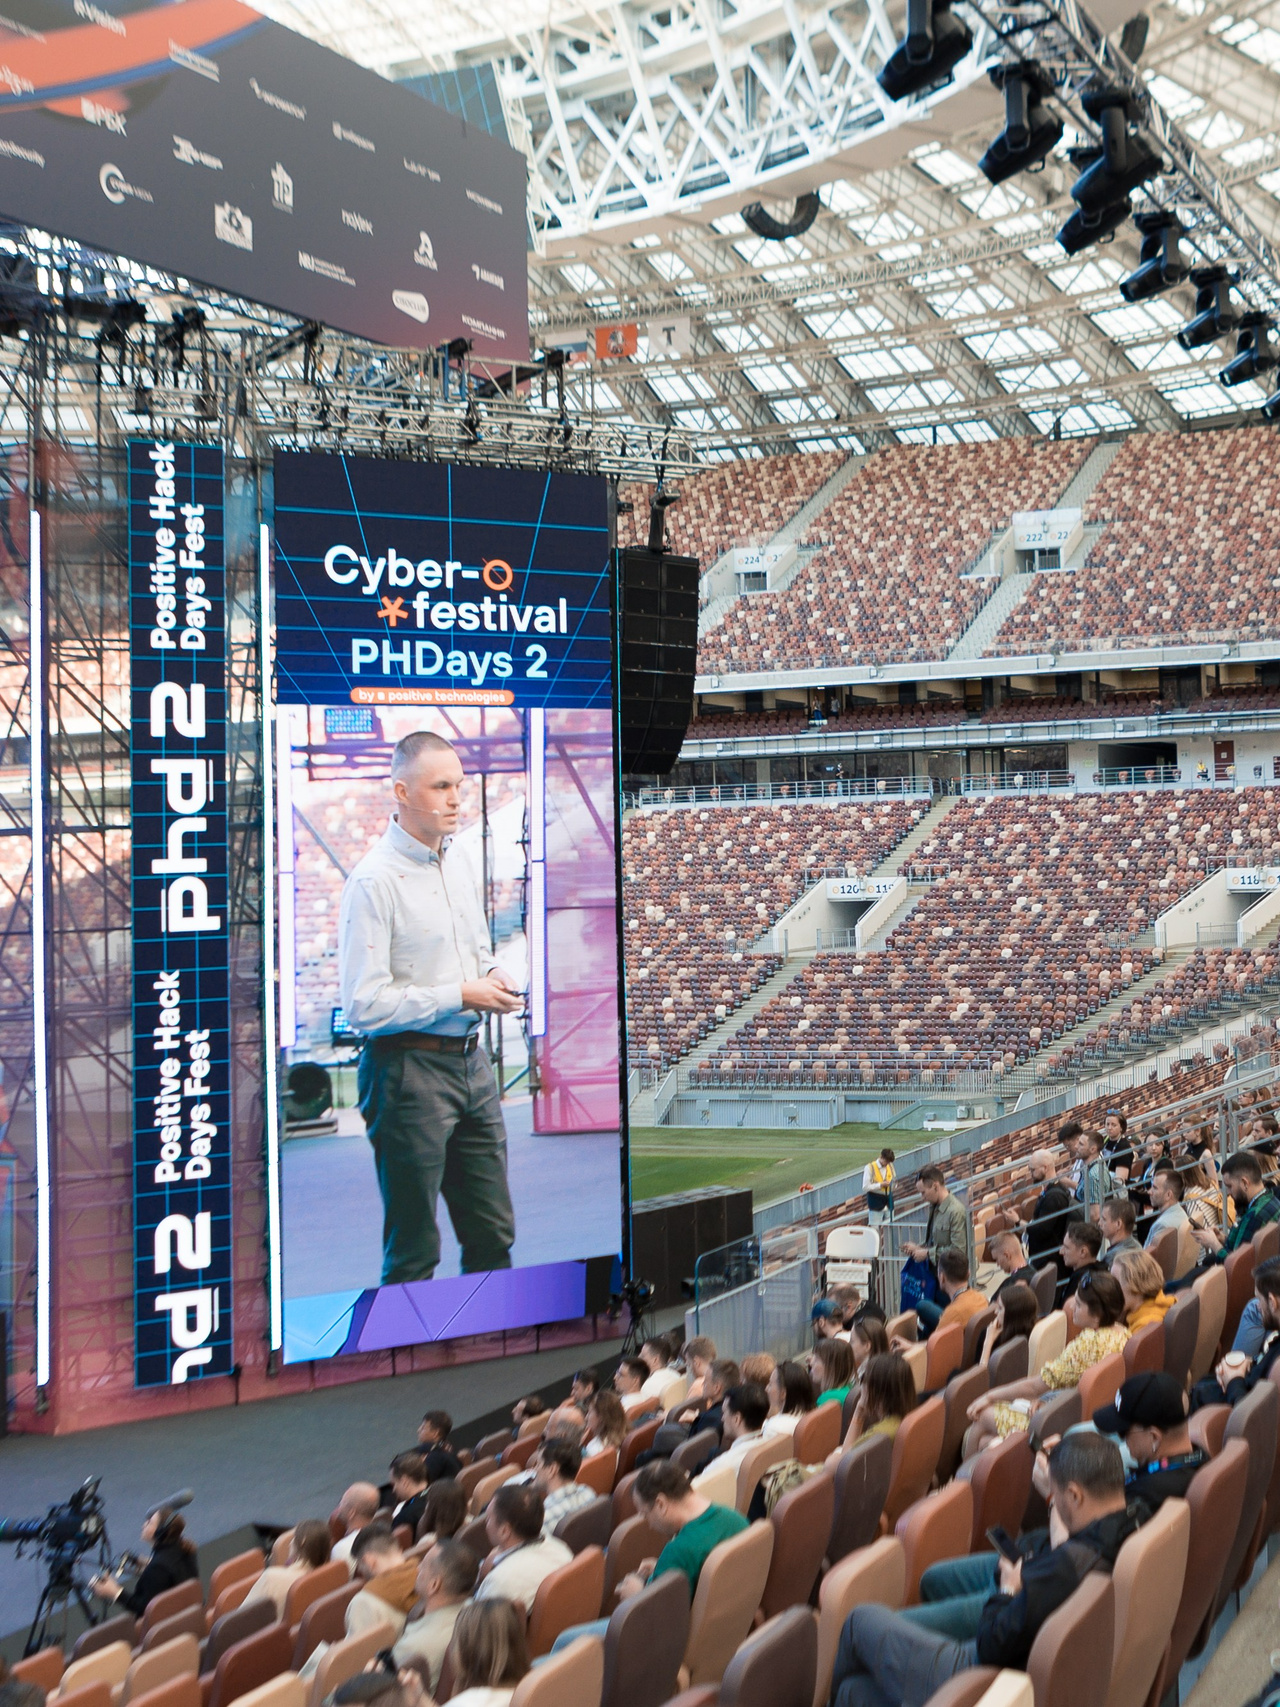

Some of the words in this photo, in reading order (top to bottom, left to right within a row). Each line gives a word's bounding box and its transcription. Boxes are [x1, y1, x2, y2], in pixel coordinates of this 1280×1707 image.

[149, 441, 176, 520] Hack
[179, 503, 205, 570] Fest
[744, 556, 760, 565] 224
[1025, 533, 1043, 542] 222
[149, 527, 177, 650] Positive
[180, 576, 212, 650] Days
[412, 590, 568, 634] festival
[351, 637, 514, 687] PHDays
[524, 643, 549, 679] 2
[150, 681, 206, 738] 2
[358, 688, 375, 703] by
[388, 689, 433, 704] positive
[435, 689, 506, 705] technologies
[840, 884, 860, 894] 120
[1240, 875, 1260, 885] 118
[153, 969, 181, 1050] Hack
[184, 1028, 211, 1097] Fest
[153, 1057, 182, 1184] Positive
[184, 1102, 218, 1181] Days
[154, 1210, 212, 1275] 2
